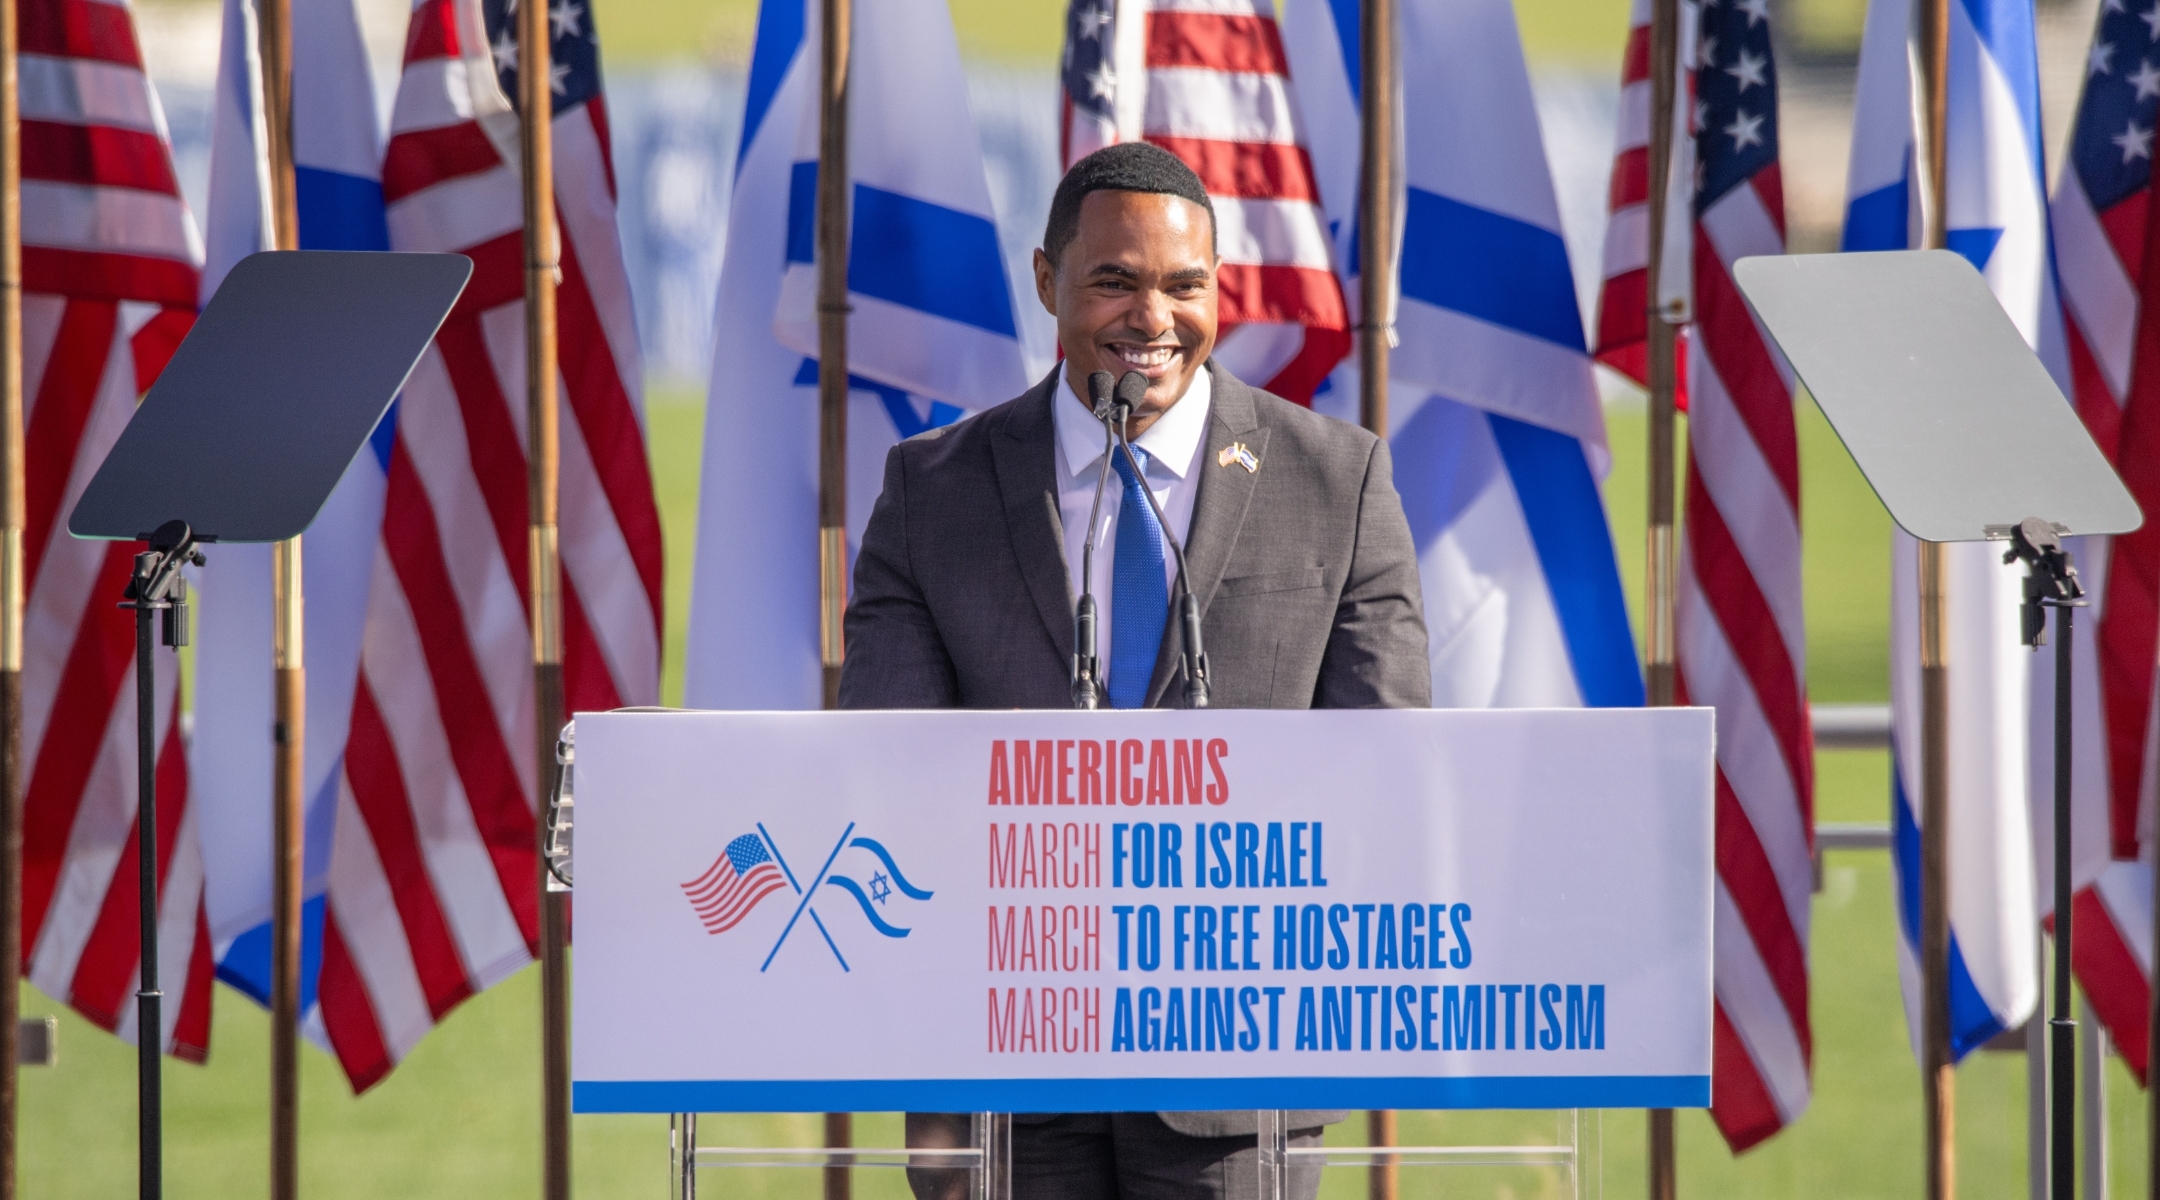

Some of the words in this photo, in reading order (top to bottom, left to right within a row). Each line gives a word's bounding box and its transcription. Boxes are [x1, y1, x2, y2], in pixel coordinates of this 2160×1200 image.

[987, 738, 1230, 806] AMERICANS
[988, 823, 1101, 888] MARCH
[1111, 822, 1183, 888] FOR
[1195, 822, 1328, 888] ISRAEL
[988, 905, 1100, 971] MARCH
[1111, 904, 1161, 971] TO
[1173, 904, 1261, 971] FREE
[1272, 903, 1473, 970] HOSTAGES
[988, 987, 1100, 1053] MARCH
[1111, 986, 1286, 1052] AGAINST
[1294, 984, 1606, 1052] ANTISEMITISM
